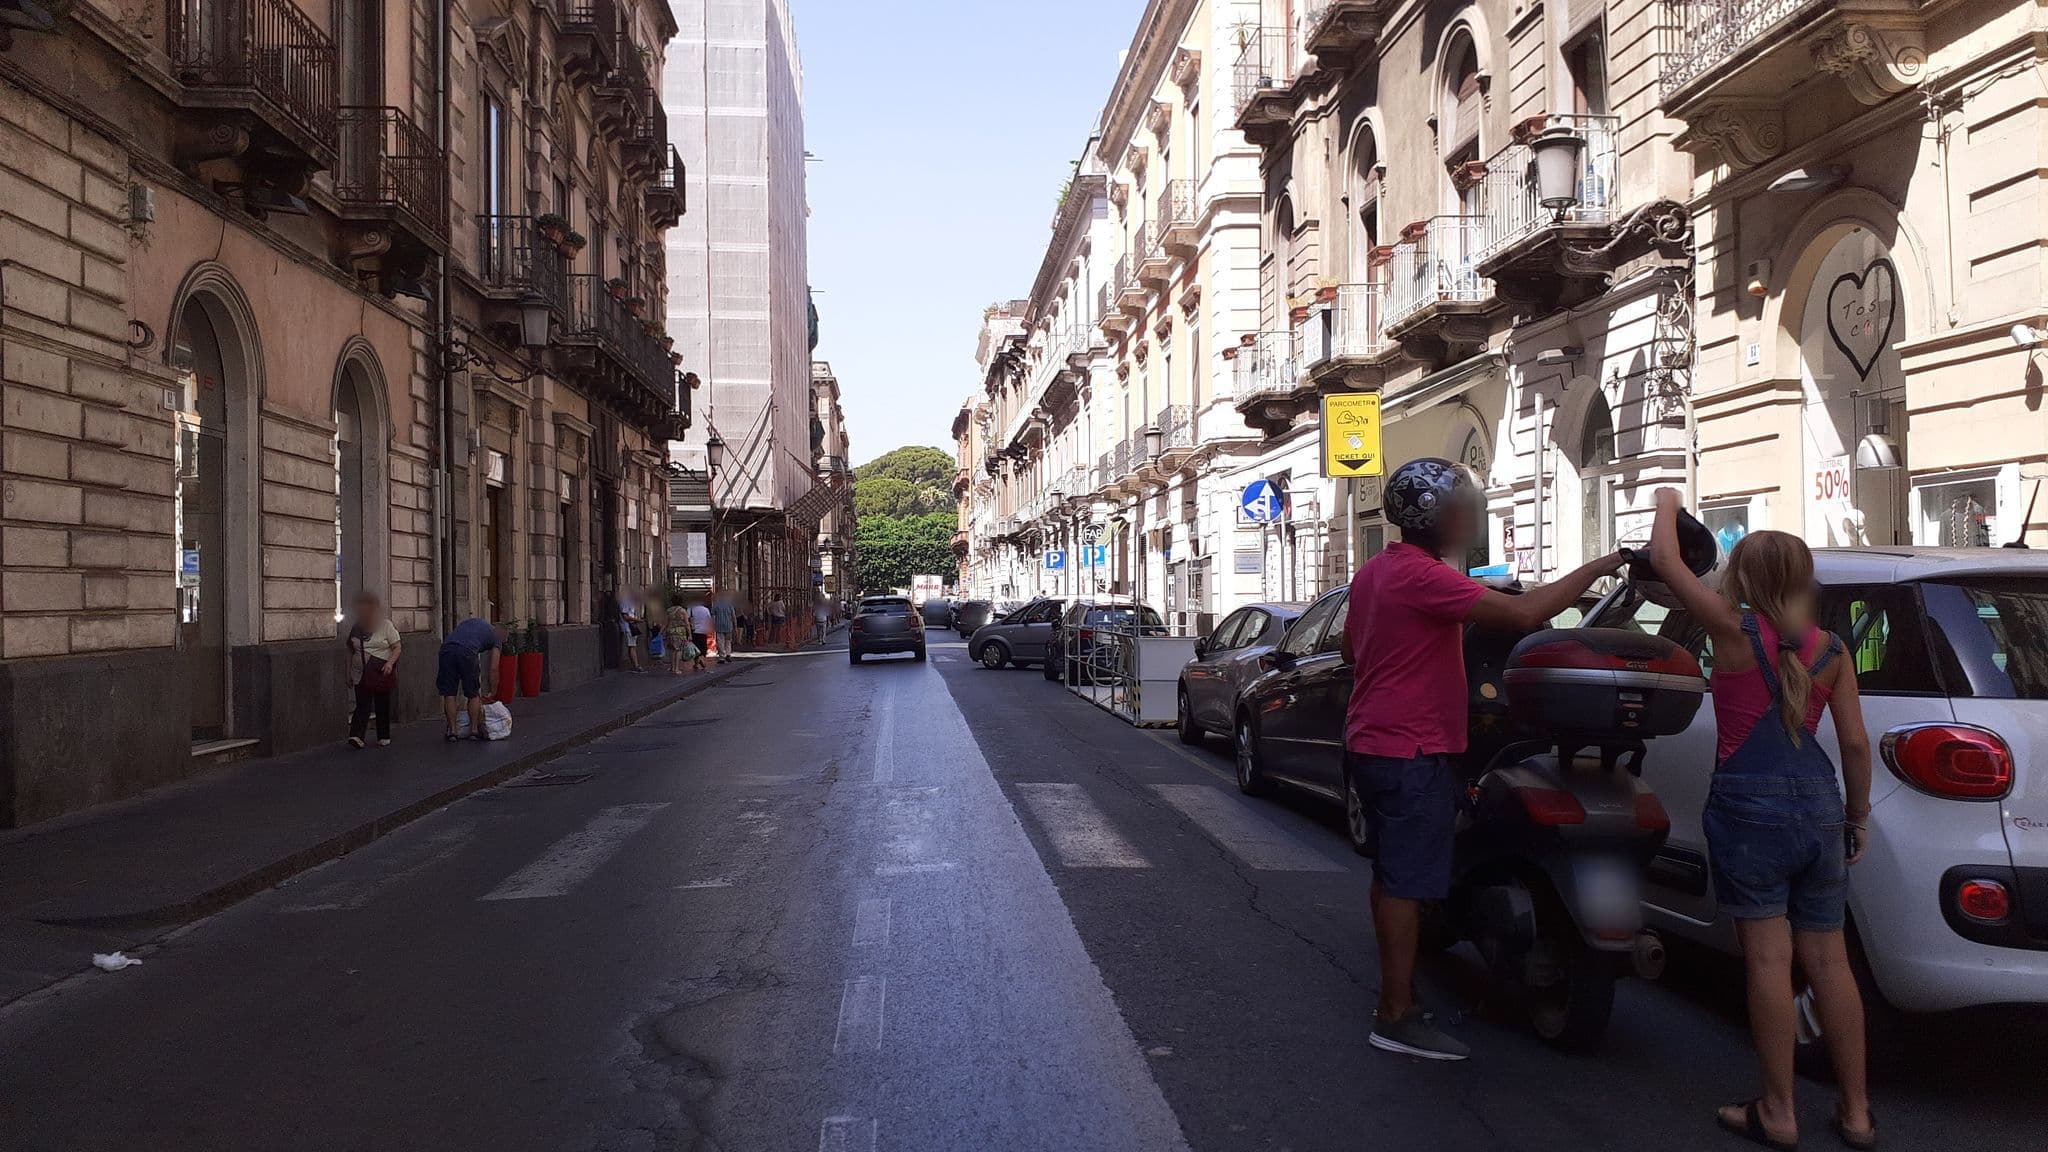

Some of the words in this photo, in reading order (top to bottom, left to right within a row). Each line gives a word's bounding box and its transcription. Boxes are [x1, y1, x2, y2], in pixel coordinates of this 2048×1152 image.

[1815, 468, 1849, 501] 50%
[1084, 529, 1102, 540] FAB
[1049, 553, 1060, 567] P
[1087, 547, 1101, 566] P
